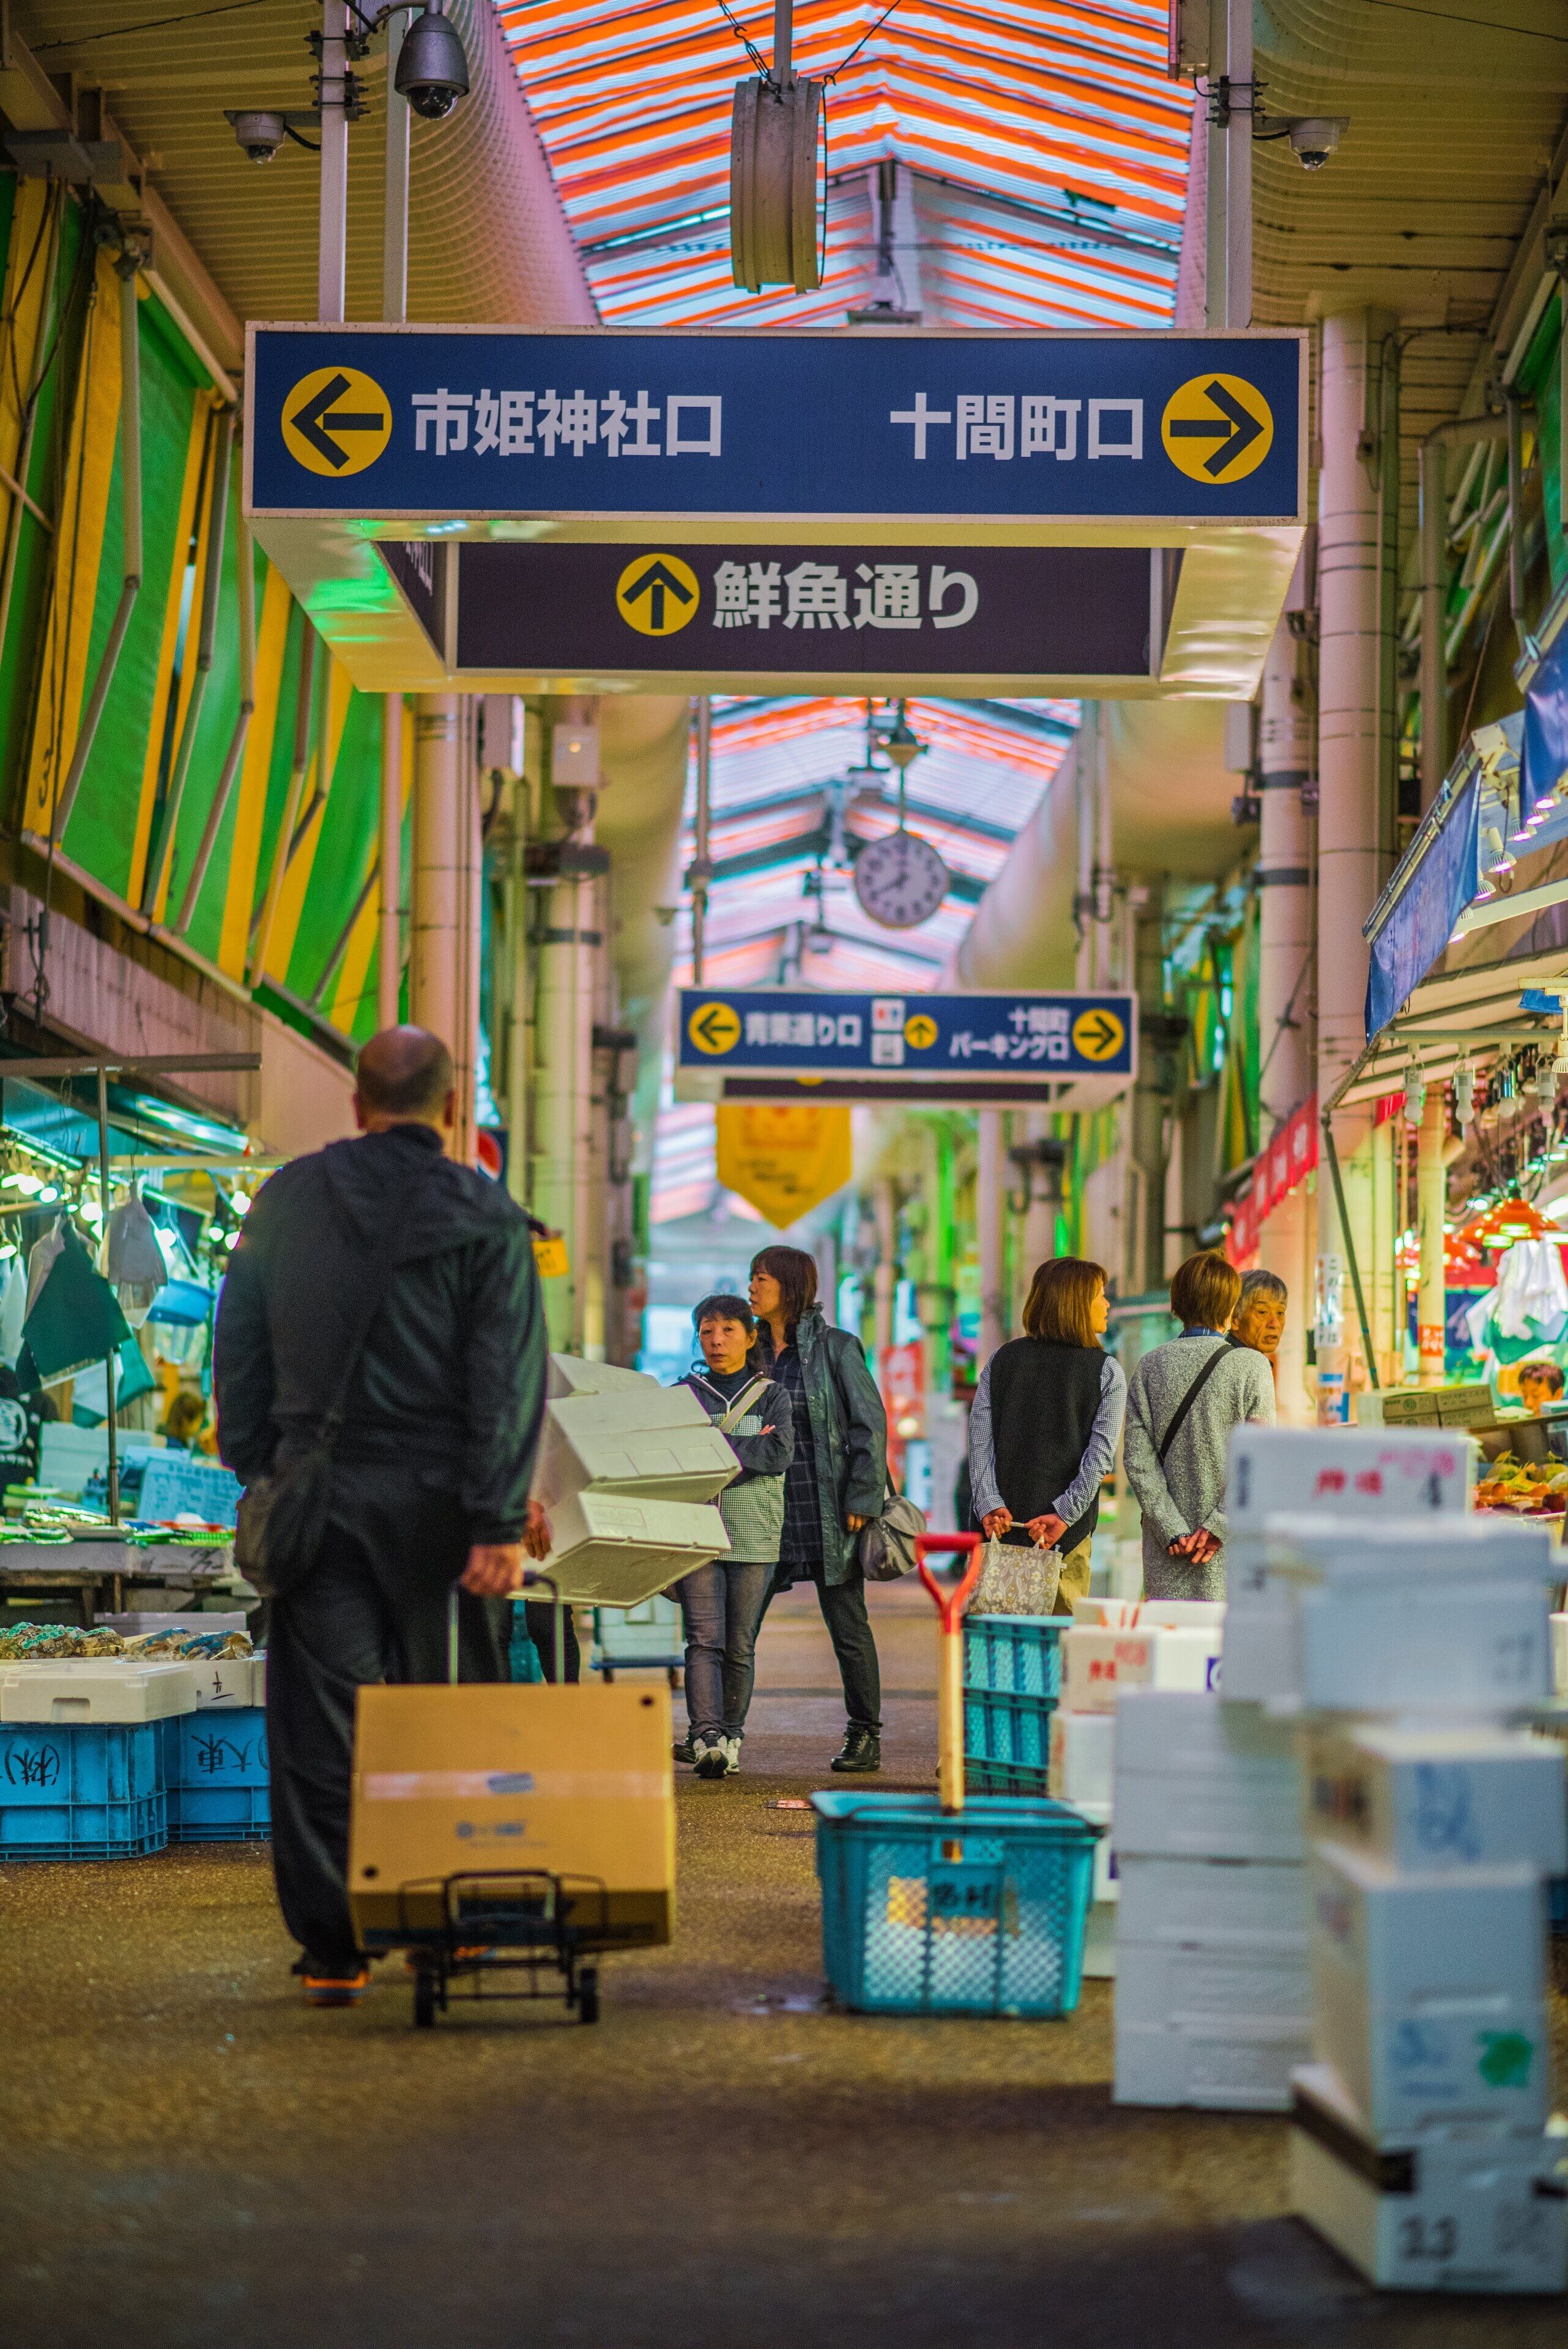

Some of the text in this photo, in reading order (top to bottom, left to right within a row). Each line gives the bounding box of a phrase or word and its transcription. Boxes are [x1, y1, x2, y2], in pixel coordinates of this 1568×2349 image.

[411, 388, 723, 458] 市姫神社口
[890, 392, 1143, 461] 十間町口
[713, 561, 978, 630] 鮮魚通り
[949, 1031, 1069, 1060] パーキング口
